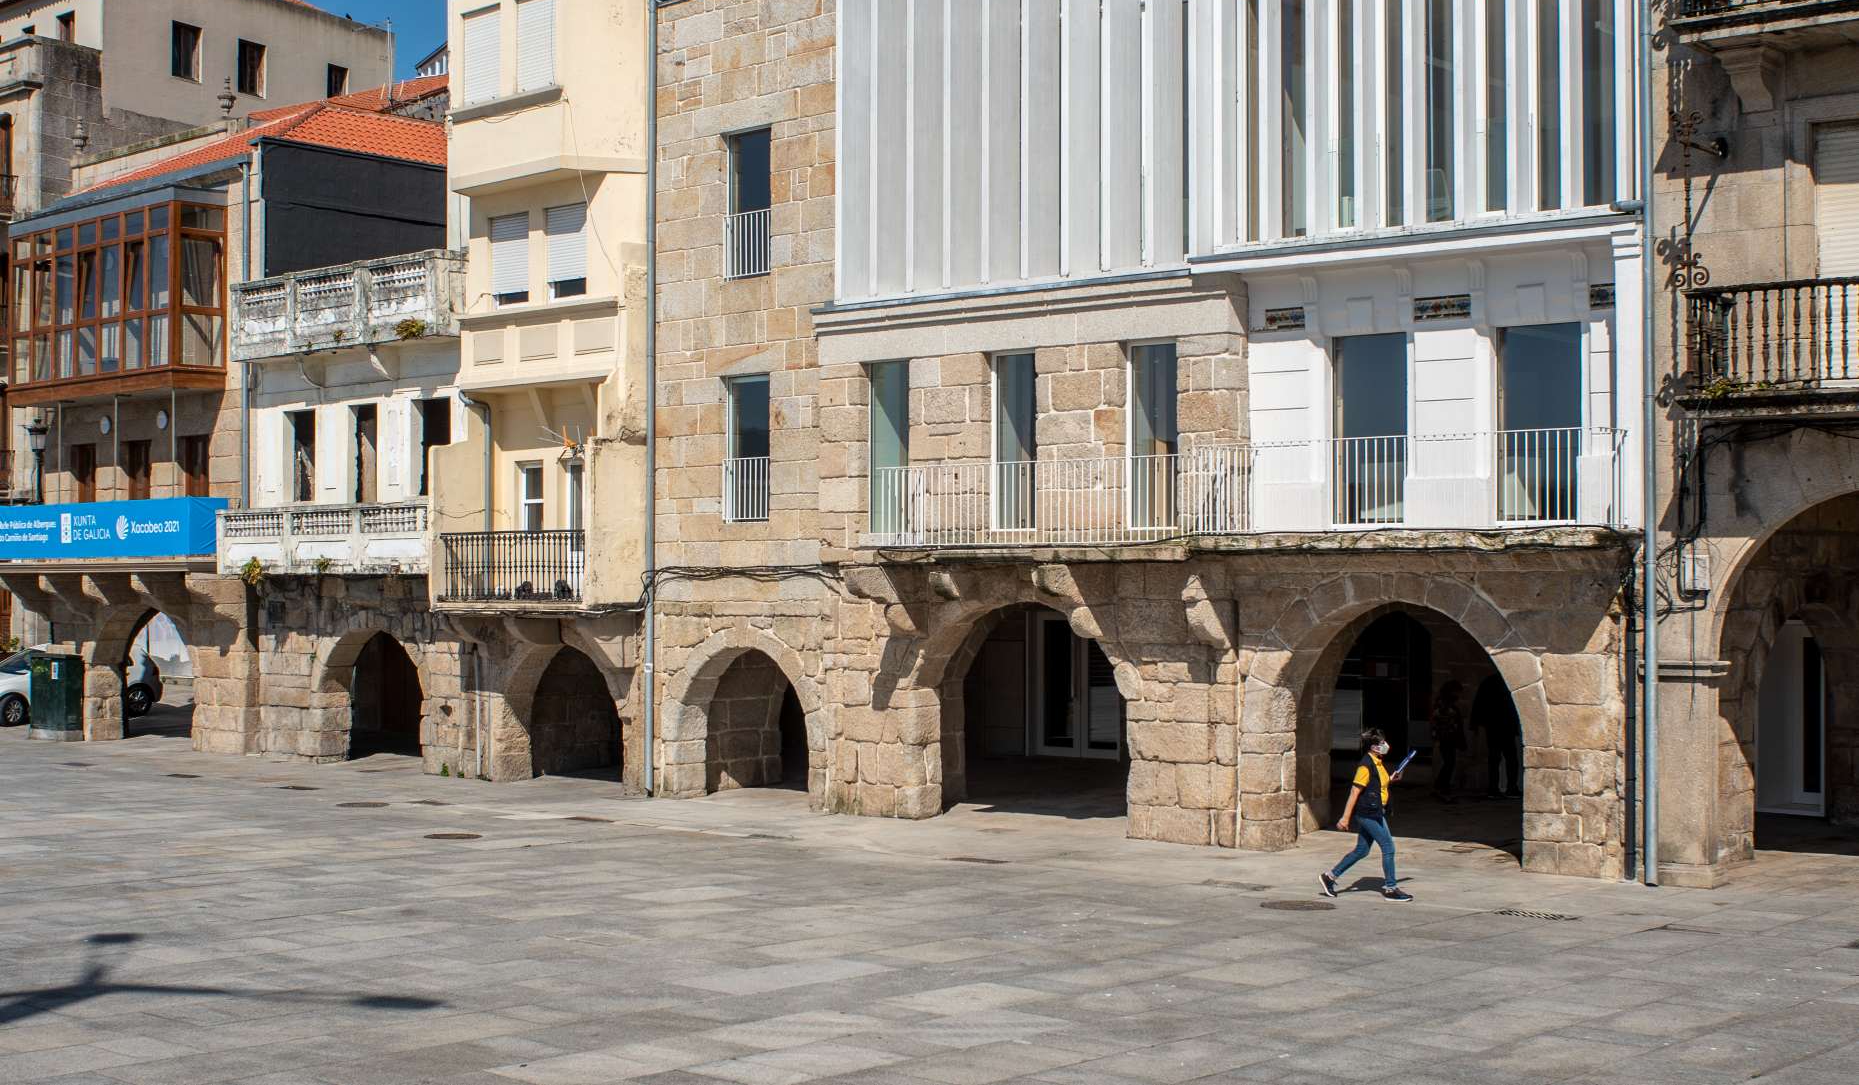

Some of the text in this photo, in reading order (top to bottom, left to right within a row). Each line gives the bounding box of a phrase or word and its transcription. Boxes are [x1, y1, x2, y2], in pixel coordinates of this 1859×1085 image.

[73, 515, 97, 527] XUNTA
[131, 520, 180, 534] Xacobeo 2021
[73, 528, 111, 541] DE GALICIA
